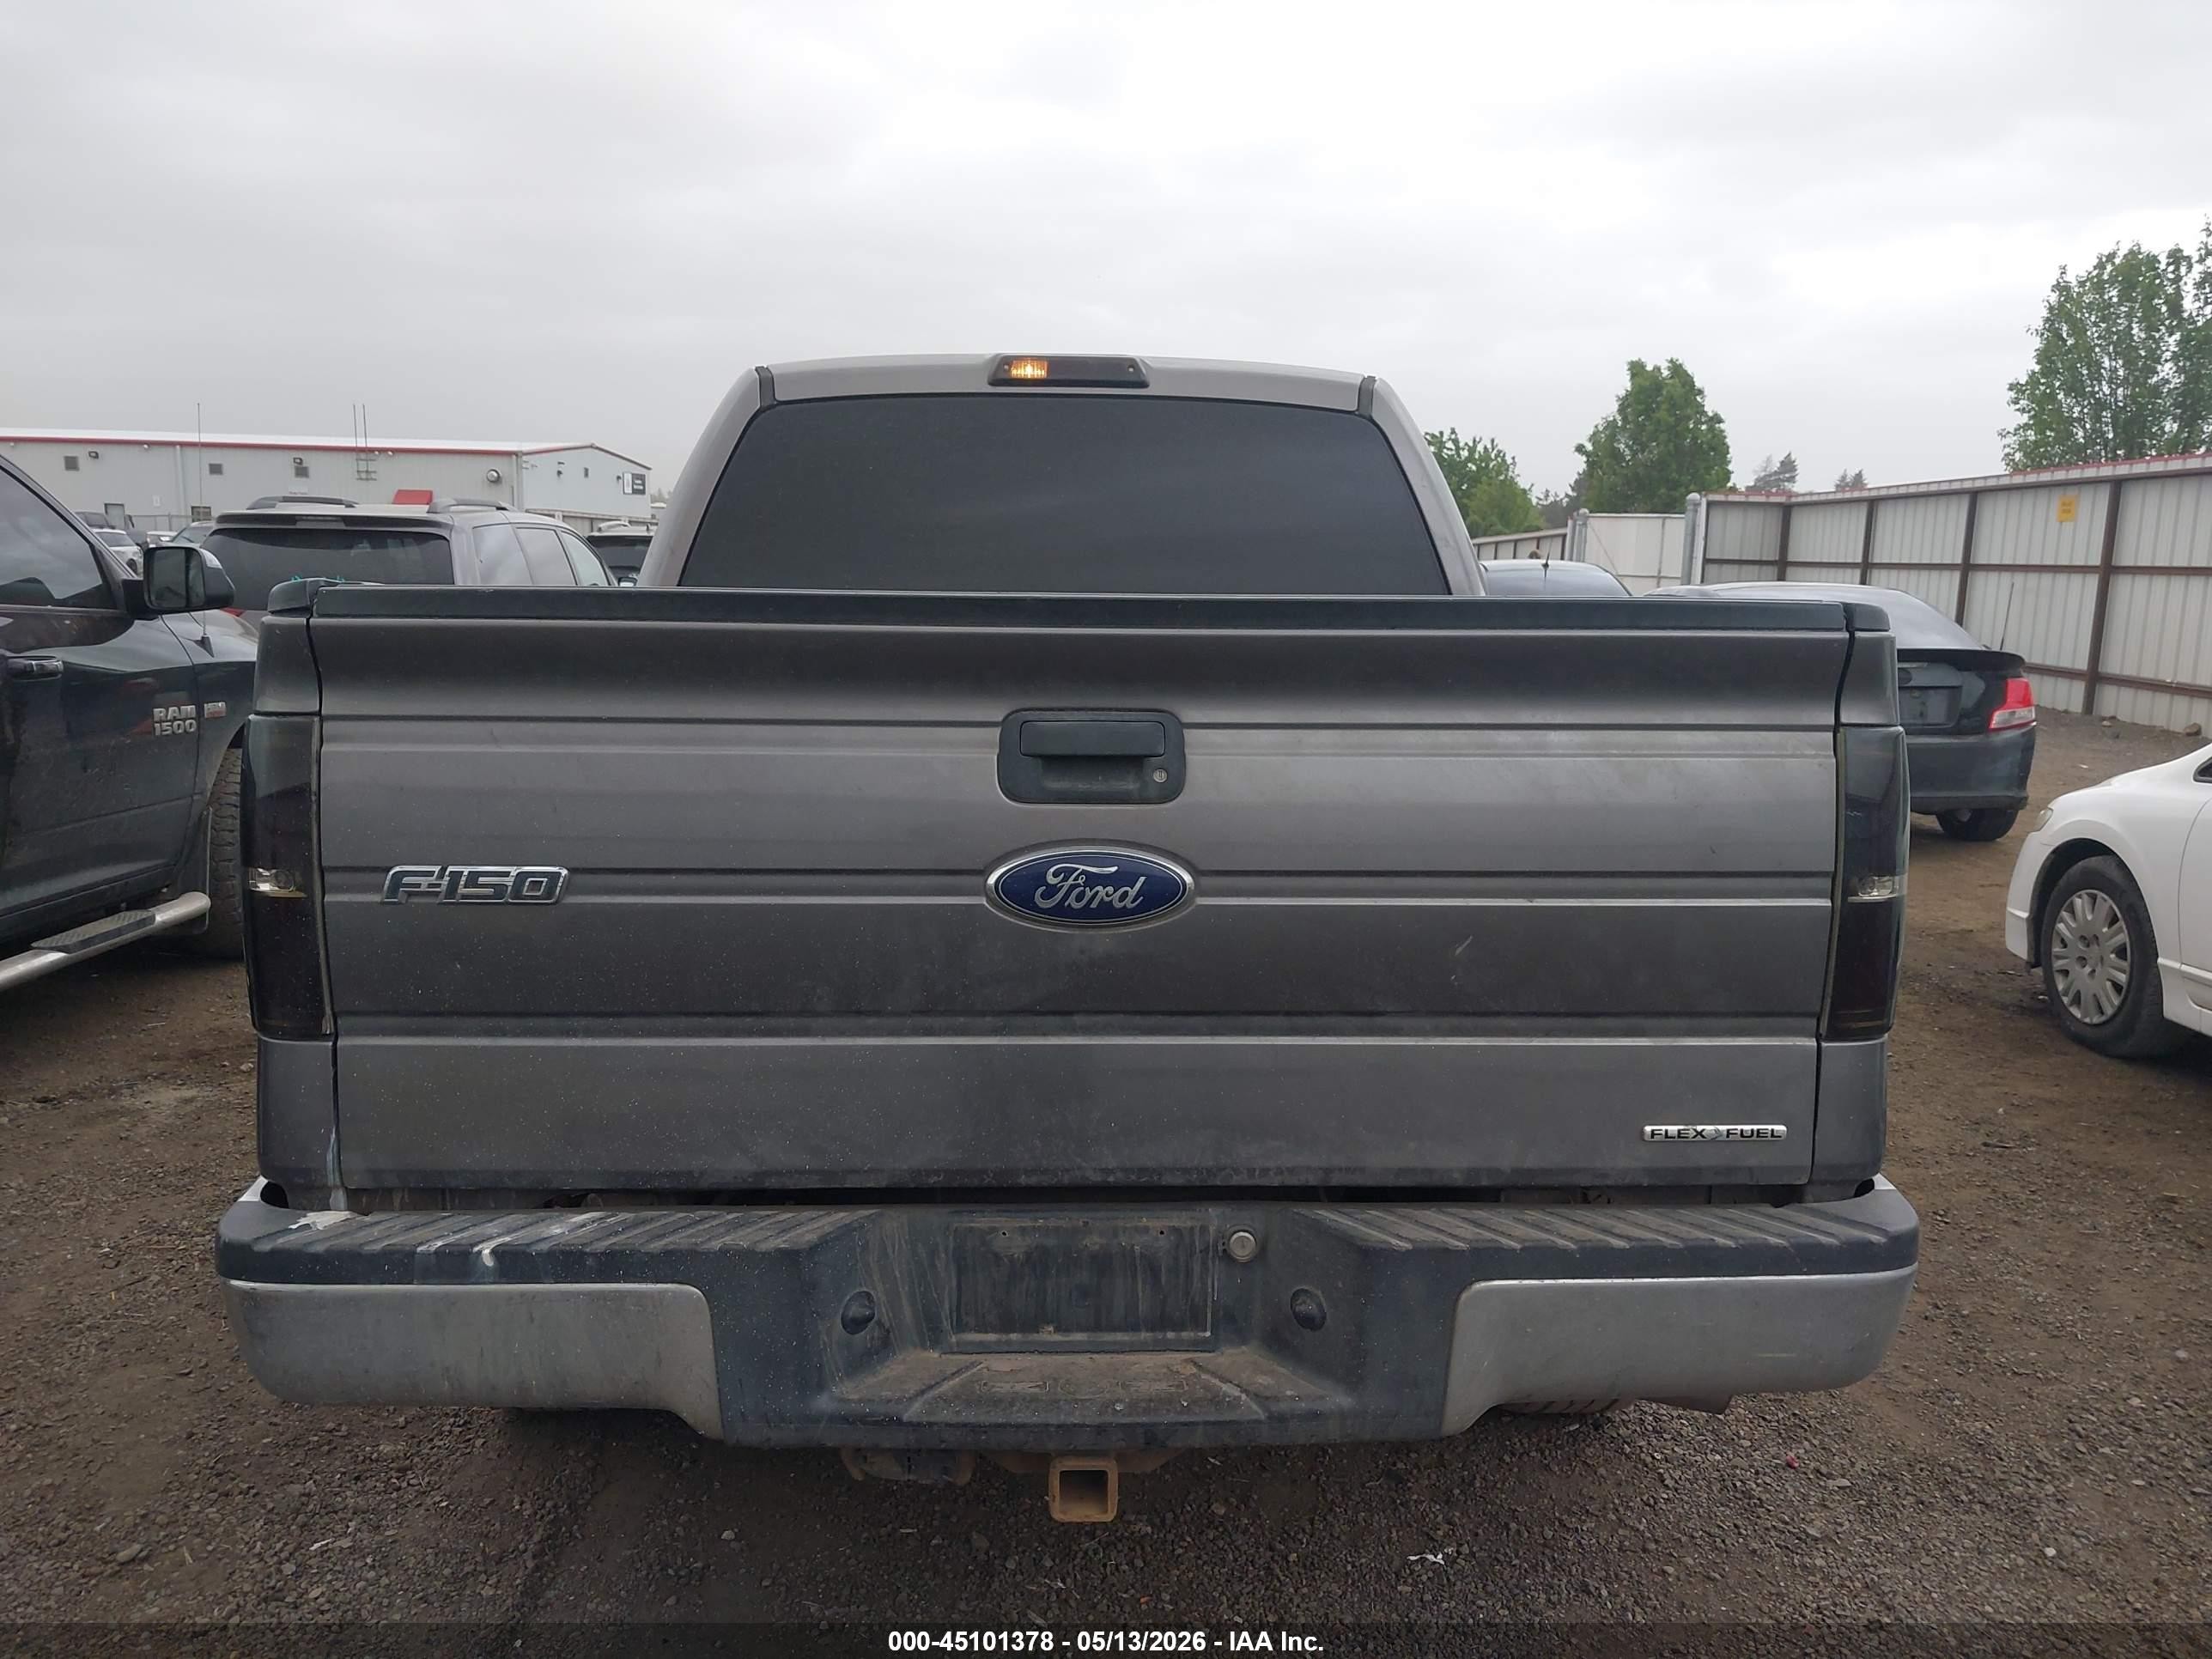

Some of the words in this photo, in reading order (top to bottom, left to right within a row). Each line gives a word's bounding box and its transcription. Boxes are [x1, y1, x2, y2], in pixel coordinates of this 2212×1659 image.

[153, 705, 196, 721] RAM
[154, 720, 197, 736] 1500
[382, 865, 568, 903] F-150
[1034, 863, 1147, 909] Ford
[1650, 1127, 1707, 1139] FLEX
[1725, 1127, 1783, 1139] FUEL
